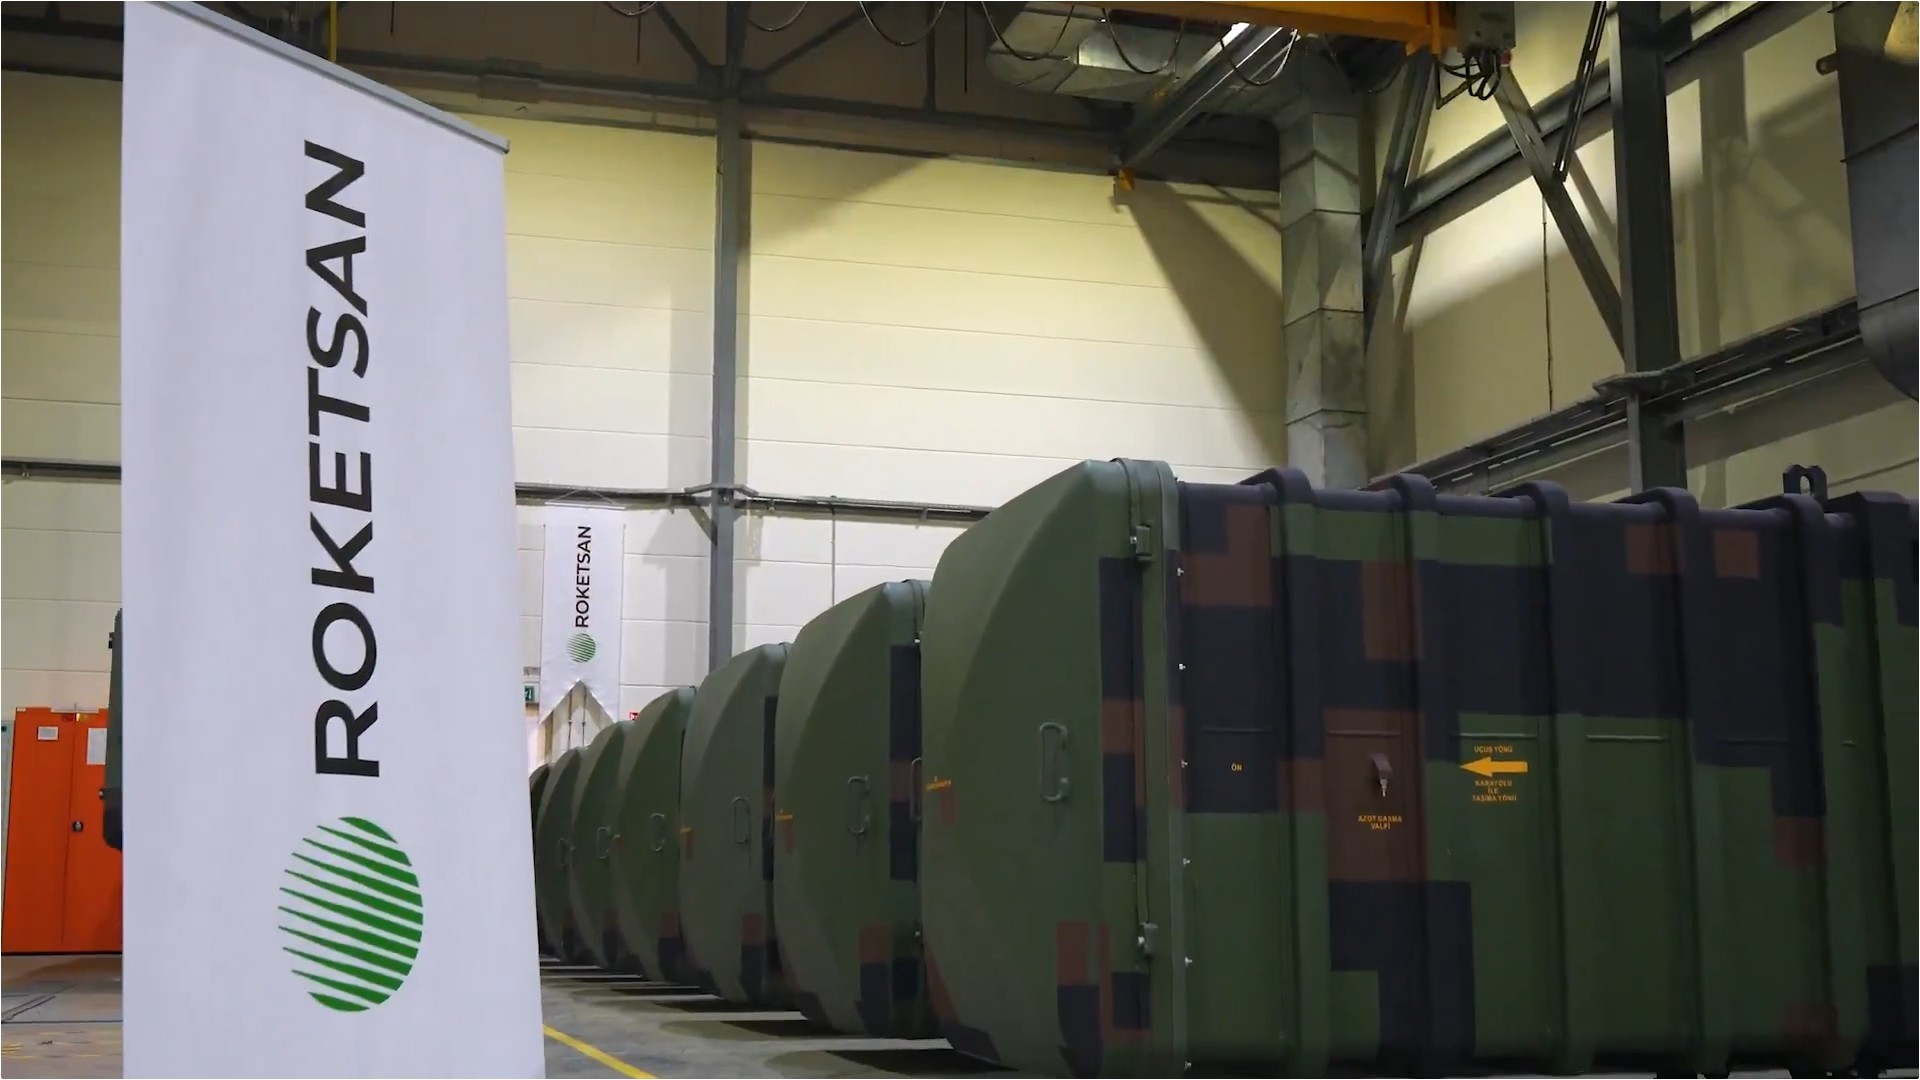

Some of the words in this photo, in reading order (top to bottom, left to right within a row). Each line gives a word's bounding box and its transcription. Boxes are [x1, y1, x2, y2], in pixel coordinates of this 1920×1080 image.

[304, 139, 380, 778] ROKETSAN
[575, 525, 592, 628] ROKETSAN
[1230, 762, 1242, 771] ÖN
[1357, 815, 1376, 823] AZOT
